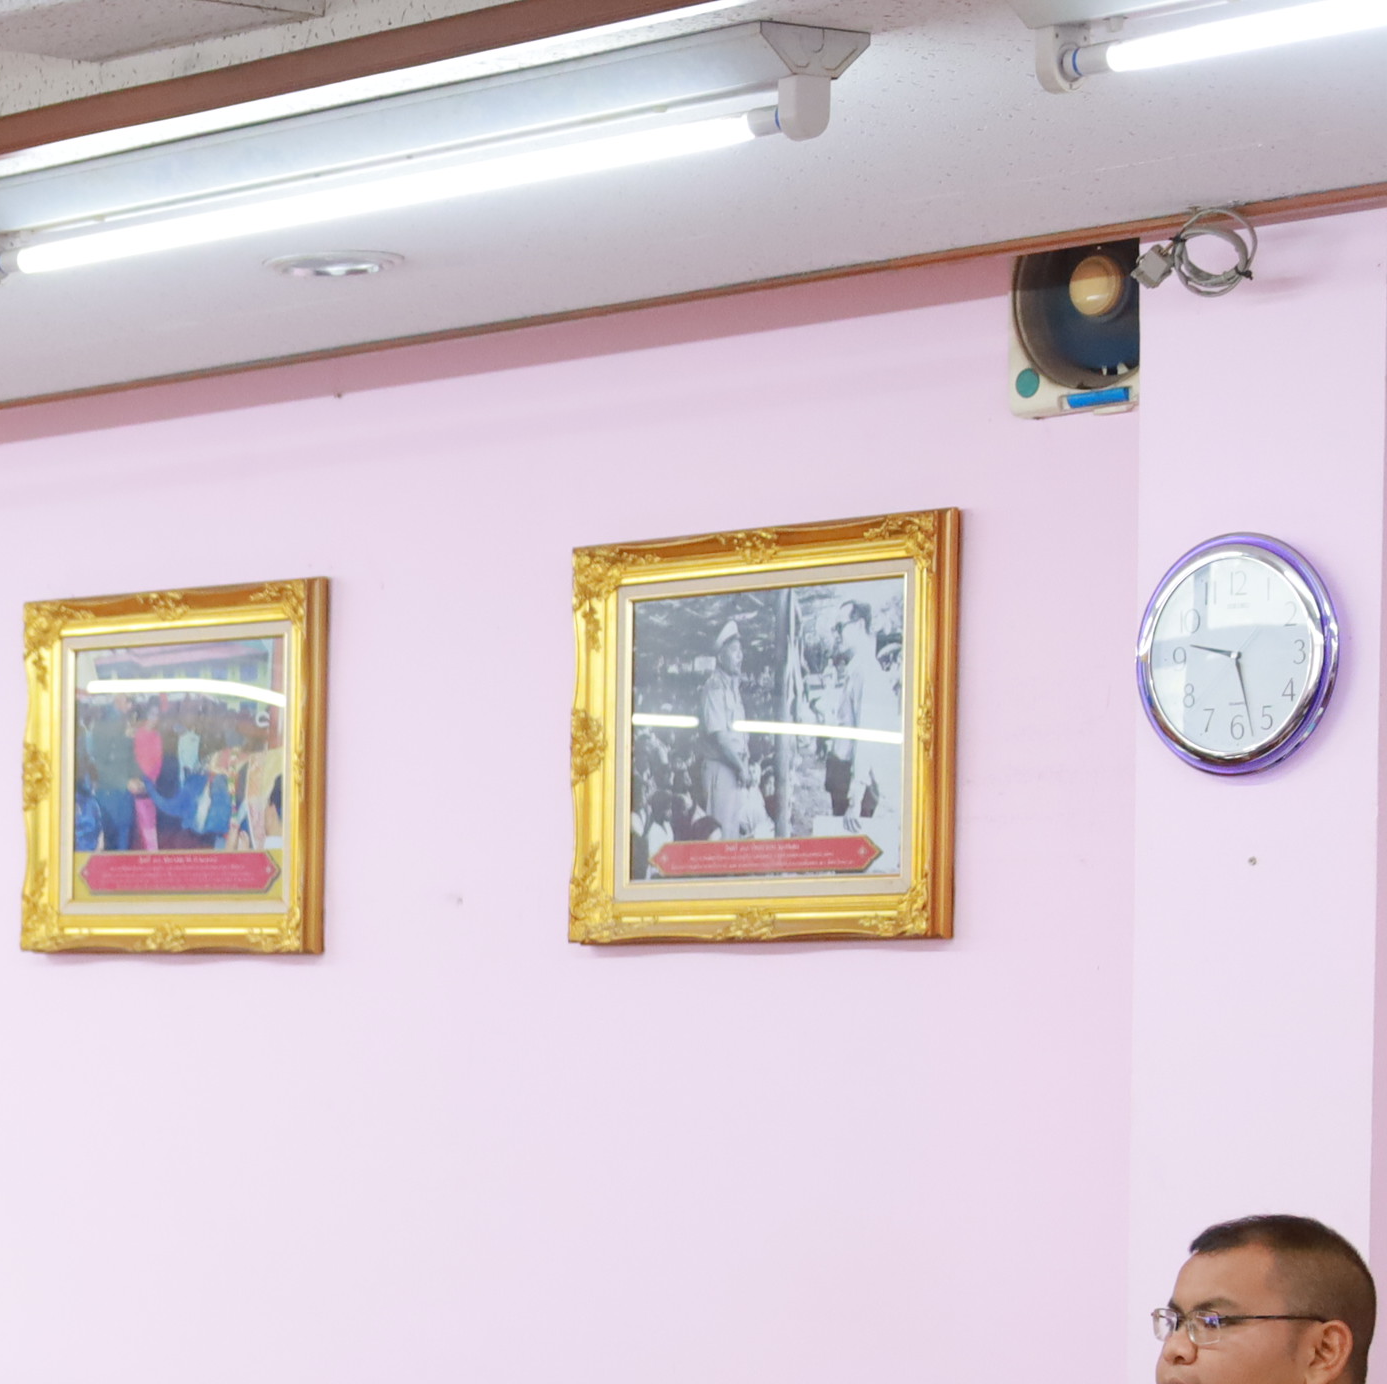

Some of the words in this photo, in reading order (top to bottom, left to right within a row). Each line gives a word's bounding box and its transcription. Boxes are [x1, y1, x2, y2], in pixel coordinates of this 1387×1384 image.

[1204, 580, 1217, 606] 11
[1230, 571, 1247, 596] 12
[1180, 608, 1201, 634] 10
[1283, 601, 1298, 627] 2
[1172, 646, 1187, 671] 9
[1292, 639, 1306, 665] 3
[1183, 683, 1196, 708] 8
[1281, 677, 1297, 702] 4
[1203, 708, 1216, 733] 7
[1230, 714, 1246, 740] 6
[1260, 705, 1274, 731] 5
